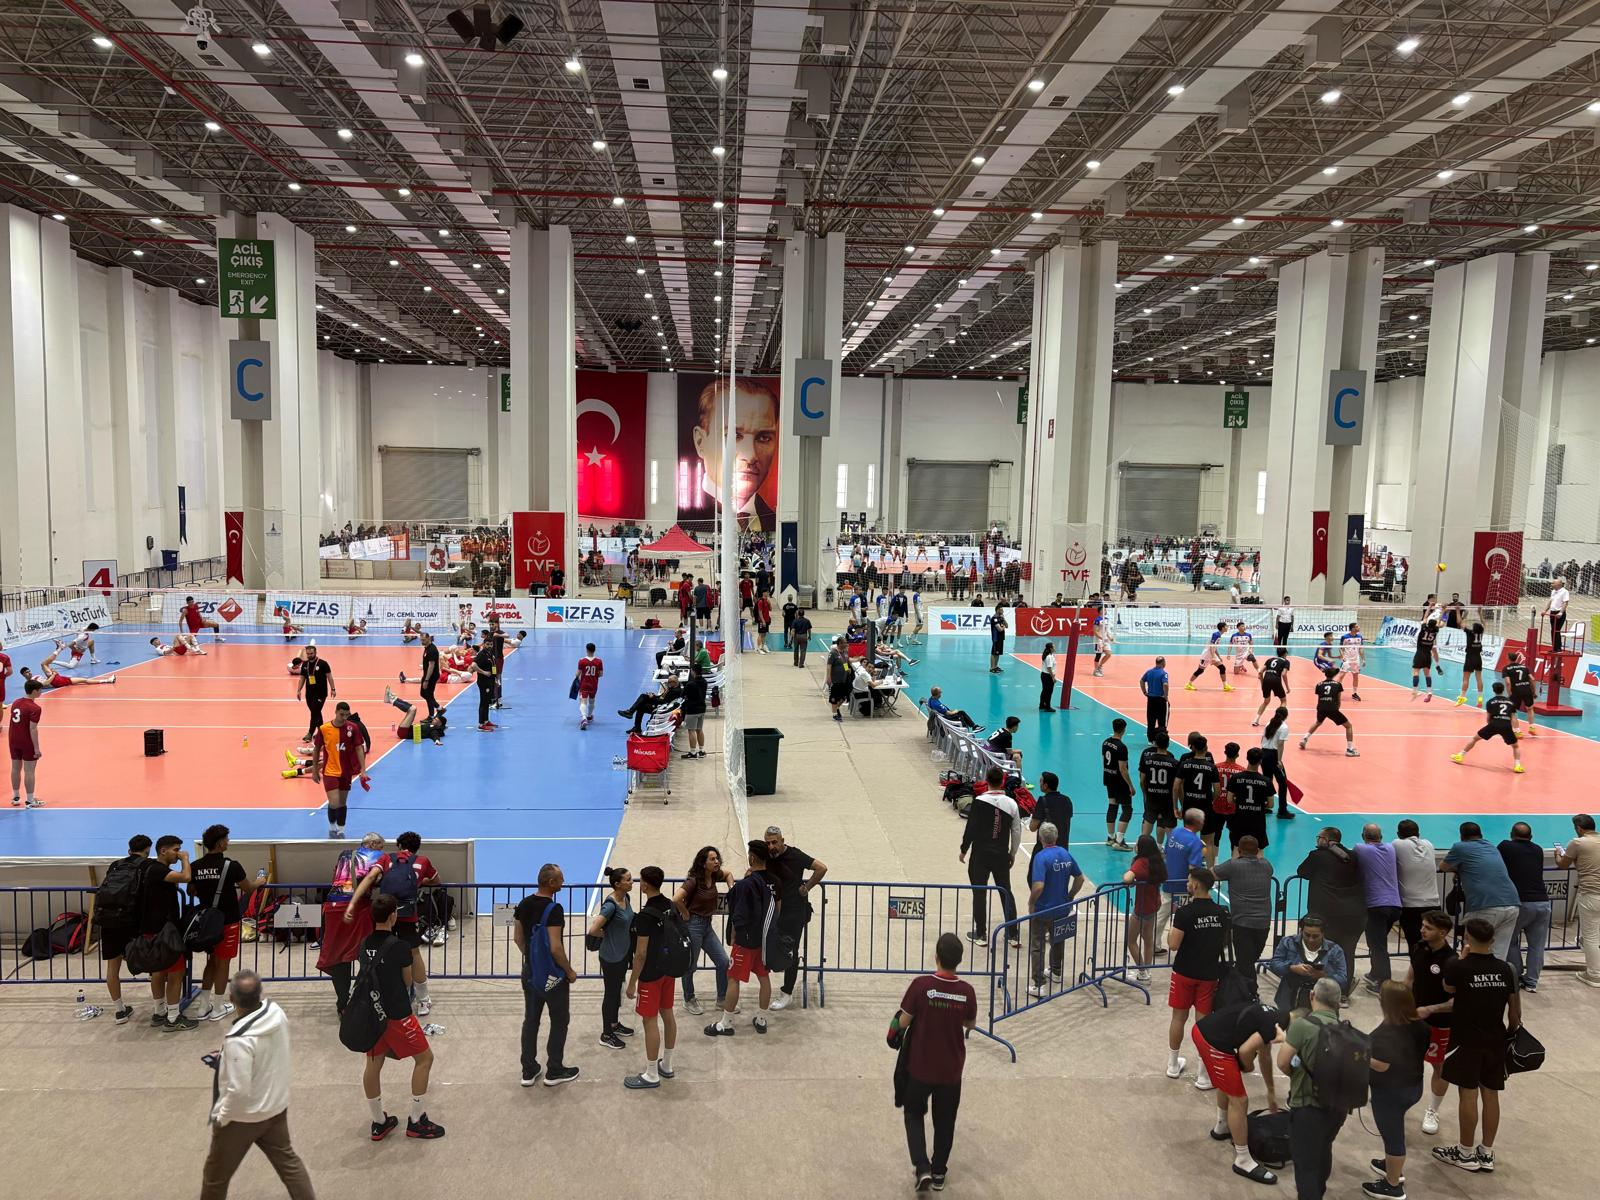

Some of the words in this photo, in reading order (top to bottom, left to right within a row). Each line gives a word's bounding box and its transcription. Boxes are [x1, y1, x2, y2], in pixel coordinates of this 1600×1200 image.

[232, 243, 261, 258] ACİL
[230, 255, 264, 271] ÇIKIŞ
[227, 272, 268, 281] EMERGENCY
[240, 280, 255, 288] EXIT
[236, 358, 264, 403] C
[801, 377, 825, 419] C
[1334, 388, 1360, 429] C
[429, 548, 446, 571] 3
[523, 559, 556, 572] TVF
[88, 567, 114, 597] 4
[1060, 569, 1090, 582] TVF
[70, 605, 107, 624] BtcTurk
[1055, 617, 1088, 631] TVF
[1297, 624, 1316, 632] AXA
[1318, 623, 1351, 632] SİGORT
[1270, 659, 1278, 668] 6
[585, 665, 597, 677] 20
[1515, 669, 1524, 681] 7
[1323, 685, 1332, 695] 3
[12, 708, 21, 723] 3
[1499, 703, 1508, 715] 2
[1105, 750, 1112, 766] 9
[1149, 767, 1168, 785] 10
[1193, 772, 1204, 791] 4
[1246, 785, 1255, 804] 1
[197, 868, 219, 876] KKTC
[1197, 915, 1219, 924] KKTC
[1473, 973, 1503, 983] KKTC
